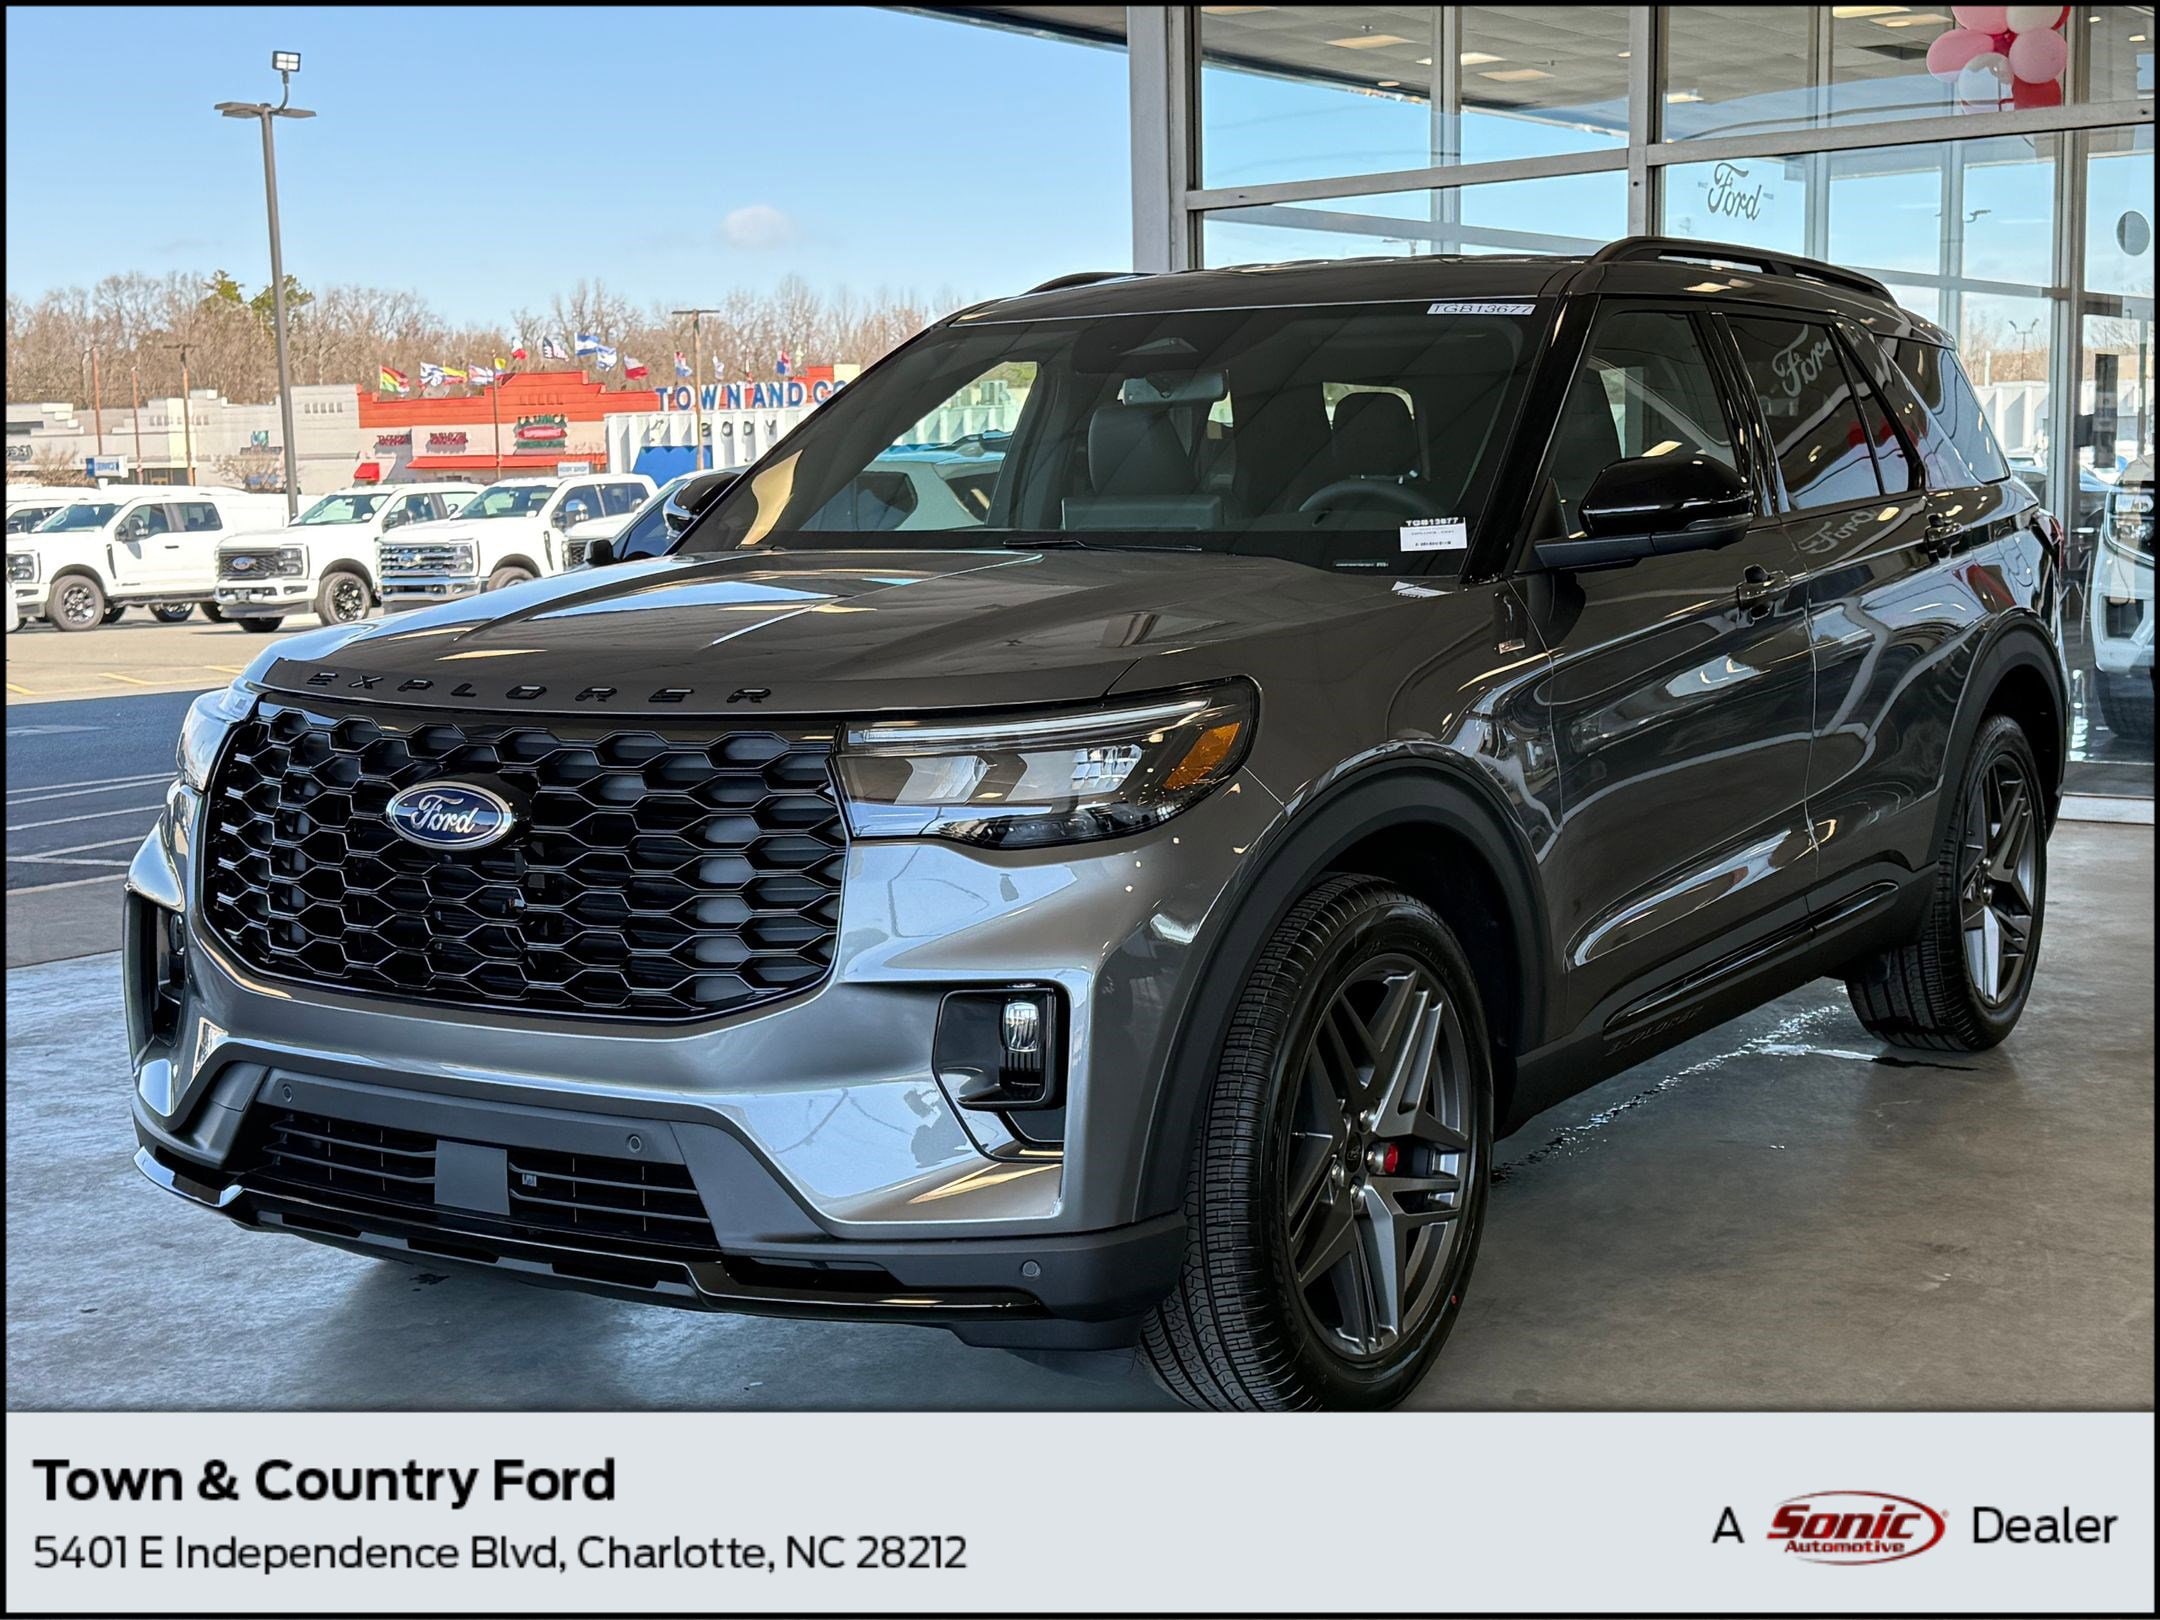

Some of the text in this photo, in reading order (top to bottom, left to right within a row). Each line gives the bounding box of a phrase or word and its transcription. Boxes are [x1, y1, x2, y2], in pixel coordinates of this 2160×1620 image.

[1708, 162, 1762, 220] Ford
[655, 383, 744, 411] TOWN
[752, 381, 806, 409] AND
[701, 418, 777, 438] BODY
[306, 671, 772, 704] EXPLORER
[410, 794, 480, 834] Ford
